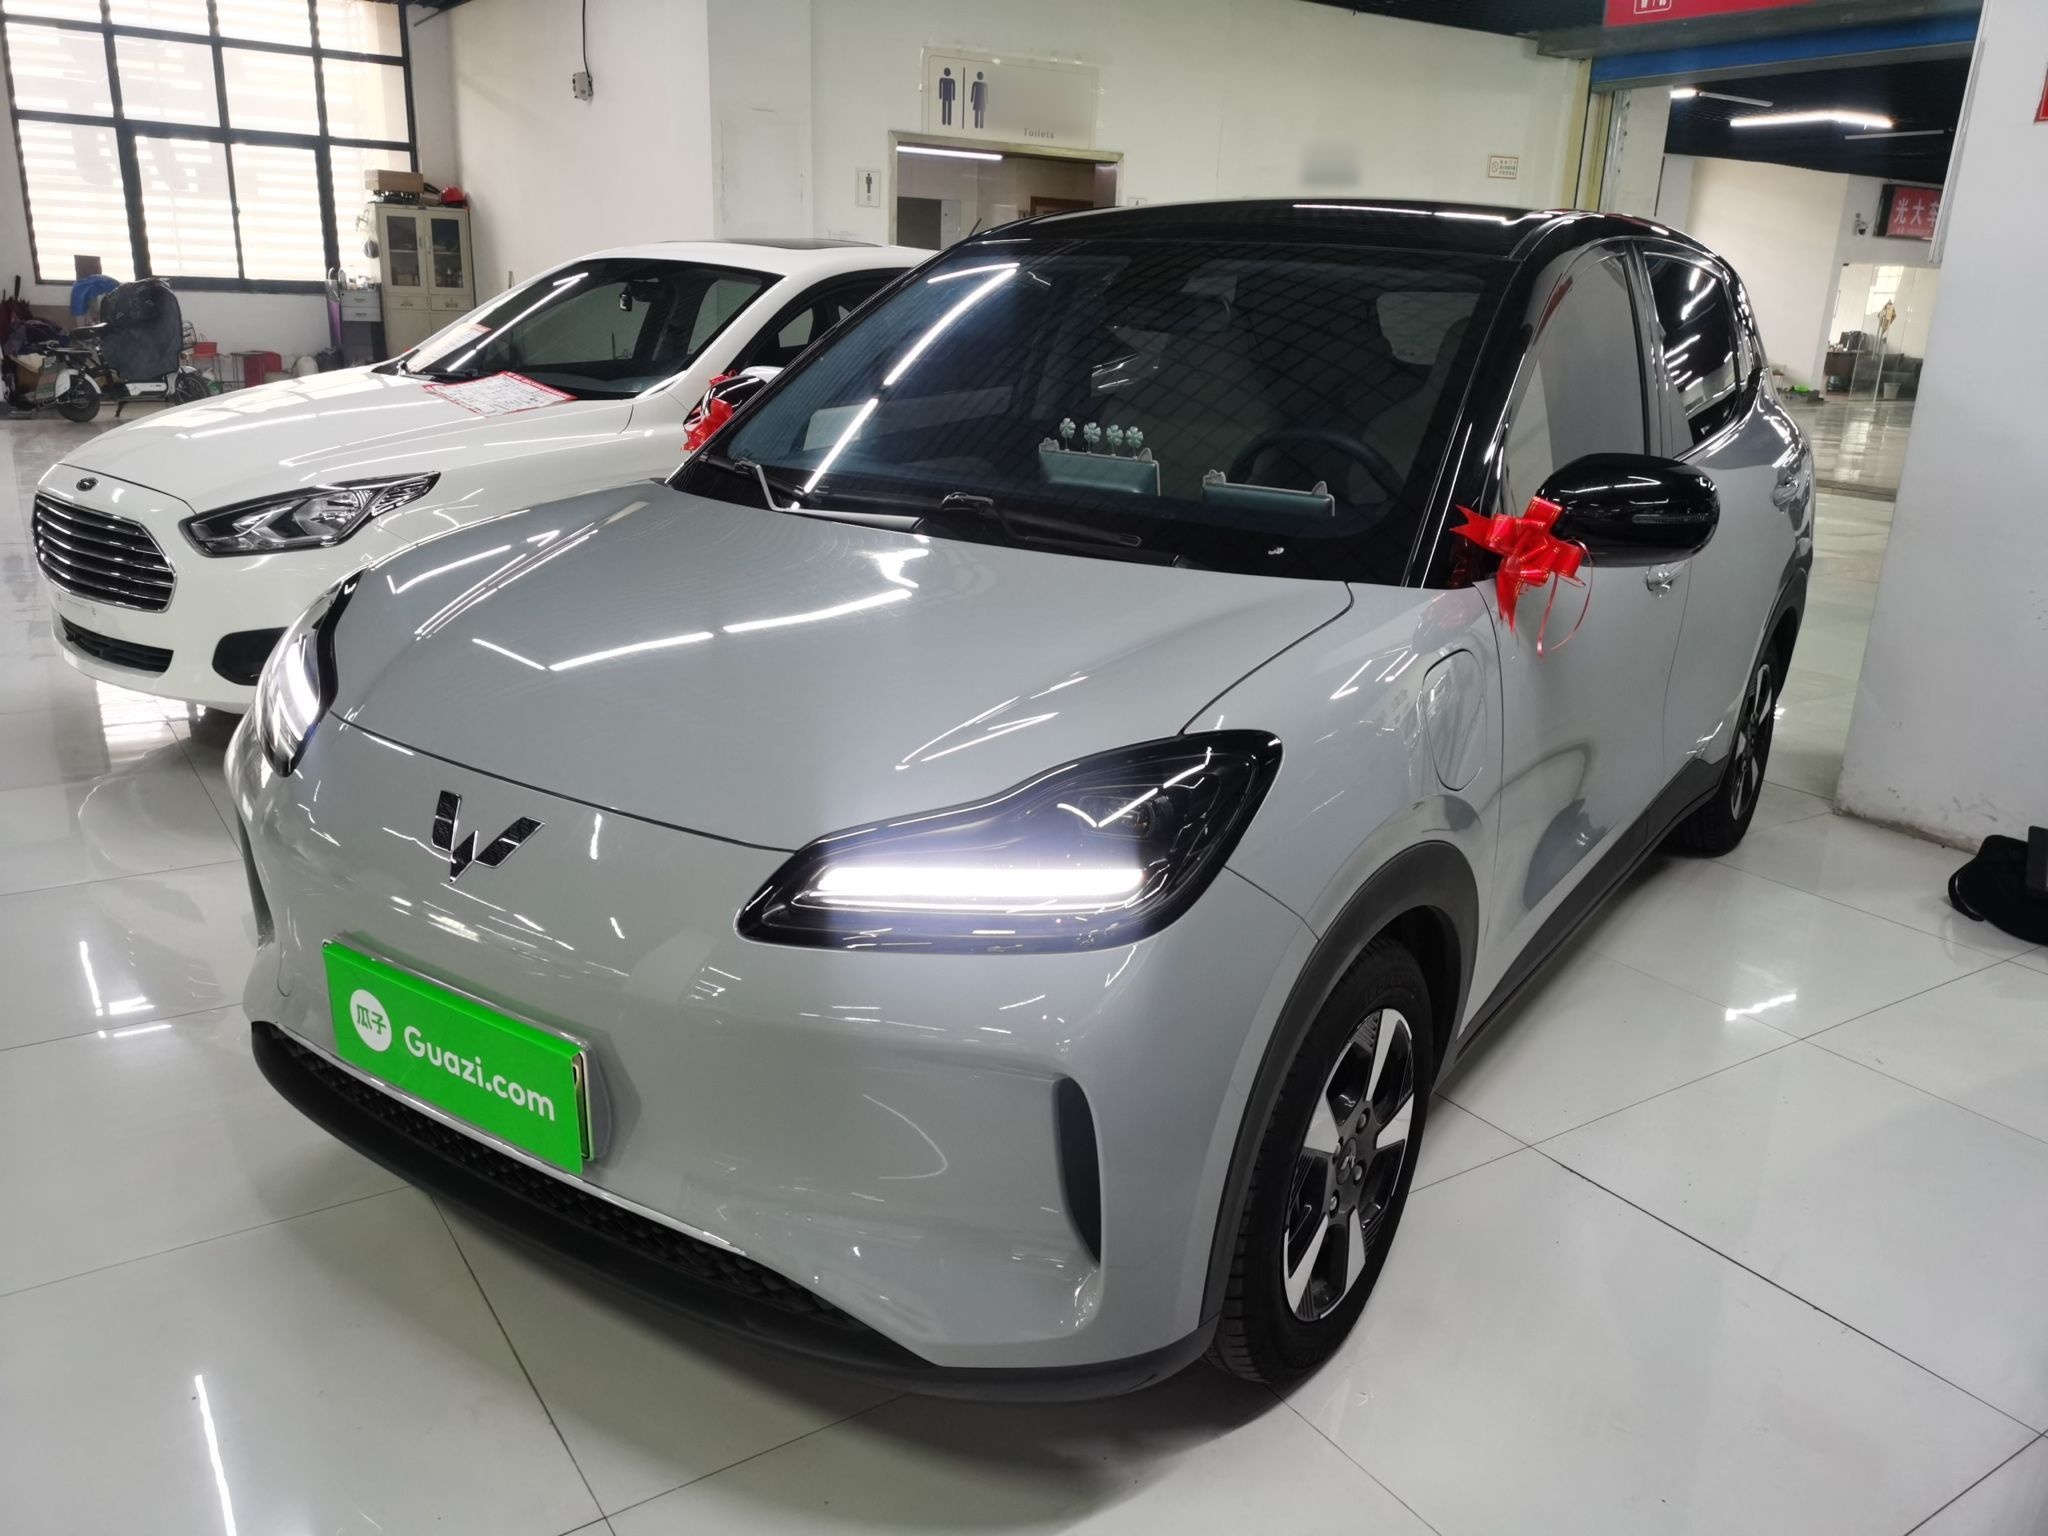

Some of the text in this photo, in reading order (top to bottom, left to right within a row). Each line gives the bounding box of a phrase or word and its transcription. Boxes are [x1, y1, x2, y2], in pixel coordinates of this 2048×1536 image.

[1023, 127, 1055, 139] Toilets
[355, 1003, 388, 1036] 瓜子
[403, 1025, 556, 1122] Guazi.com
